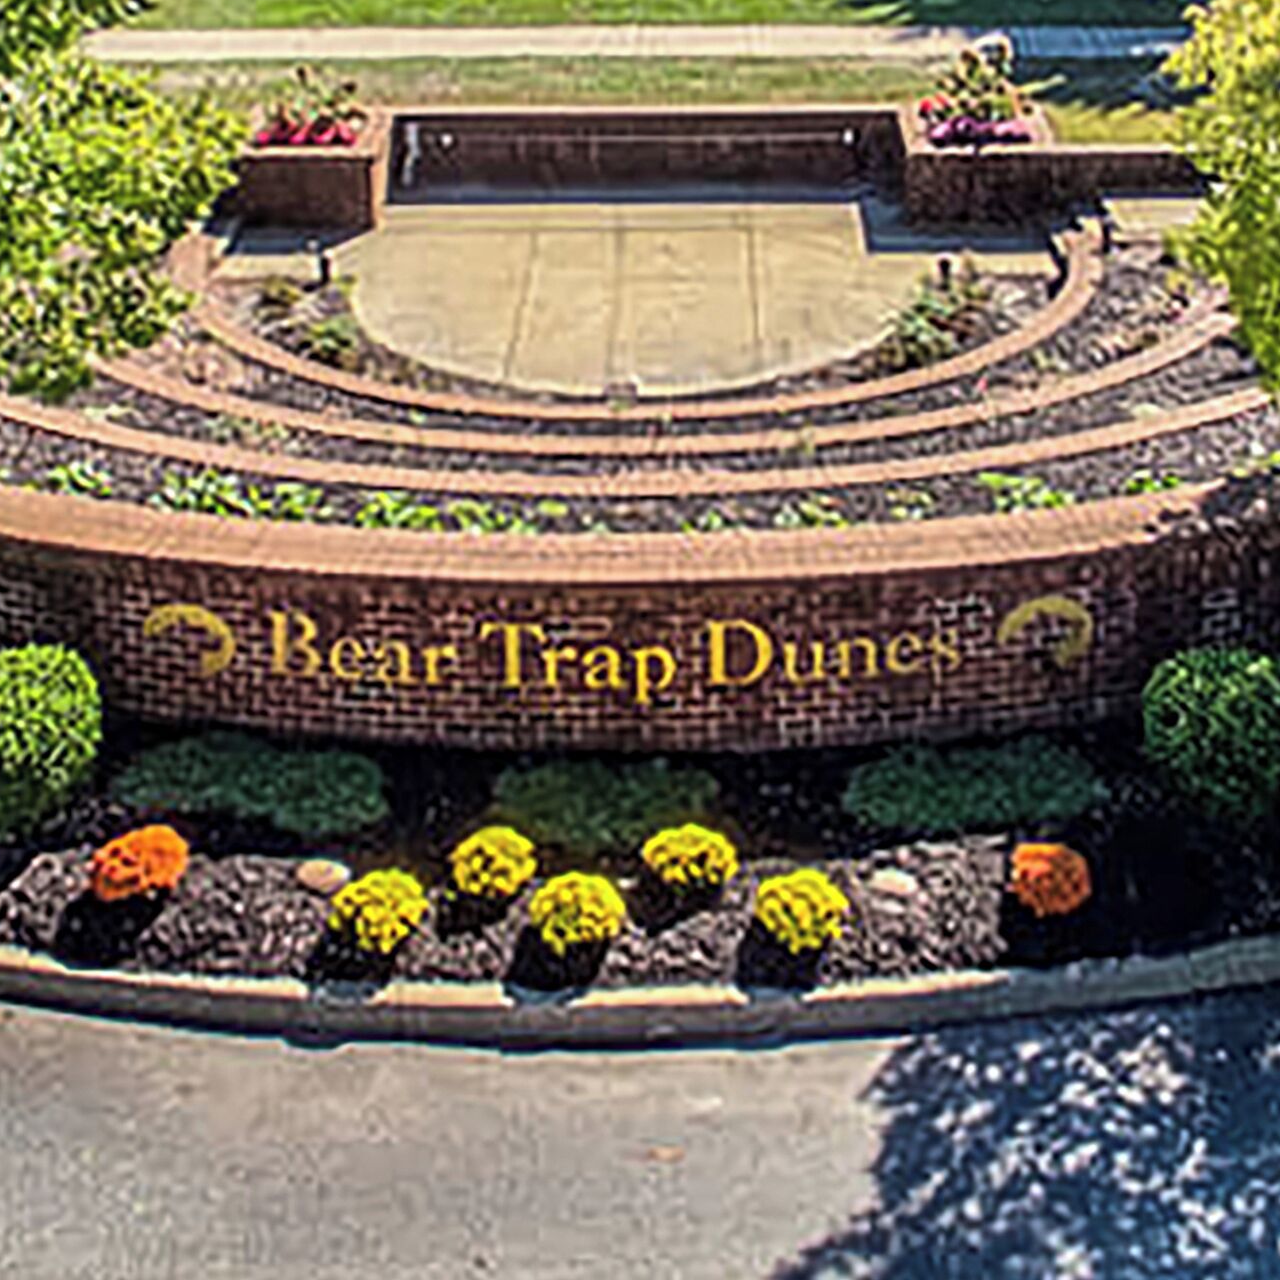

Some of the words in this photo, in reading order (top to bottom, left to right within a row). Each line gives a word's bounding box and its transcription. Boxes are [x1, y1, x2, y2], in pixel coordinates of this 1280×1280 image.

[268, 610, 459, 684] Bear
[479, 621, 676, 703] Trap
[706, 618, 961, 686] Dunes
